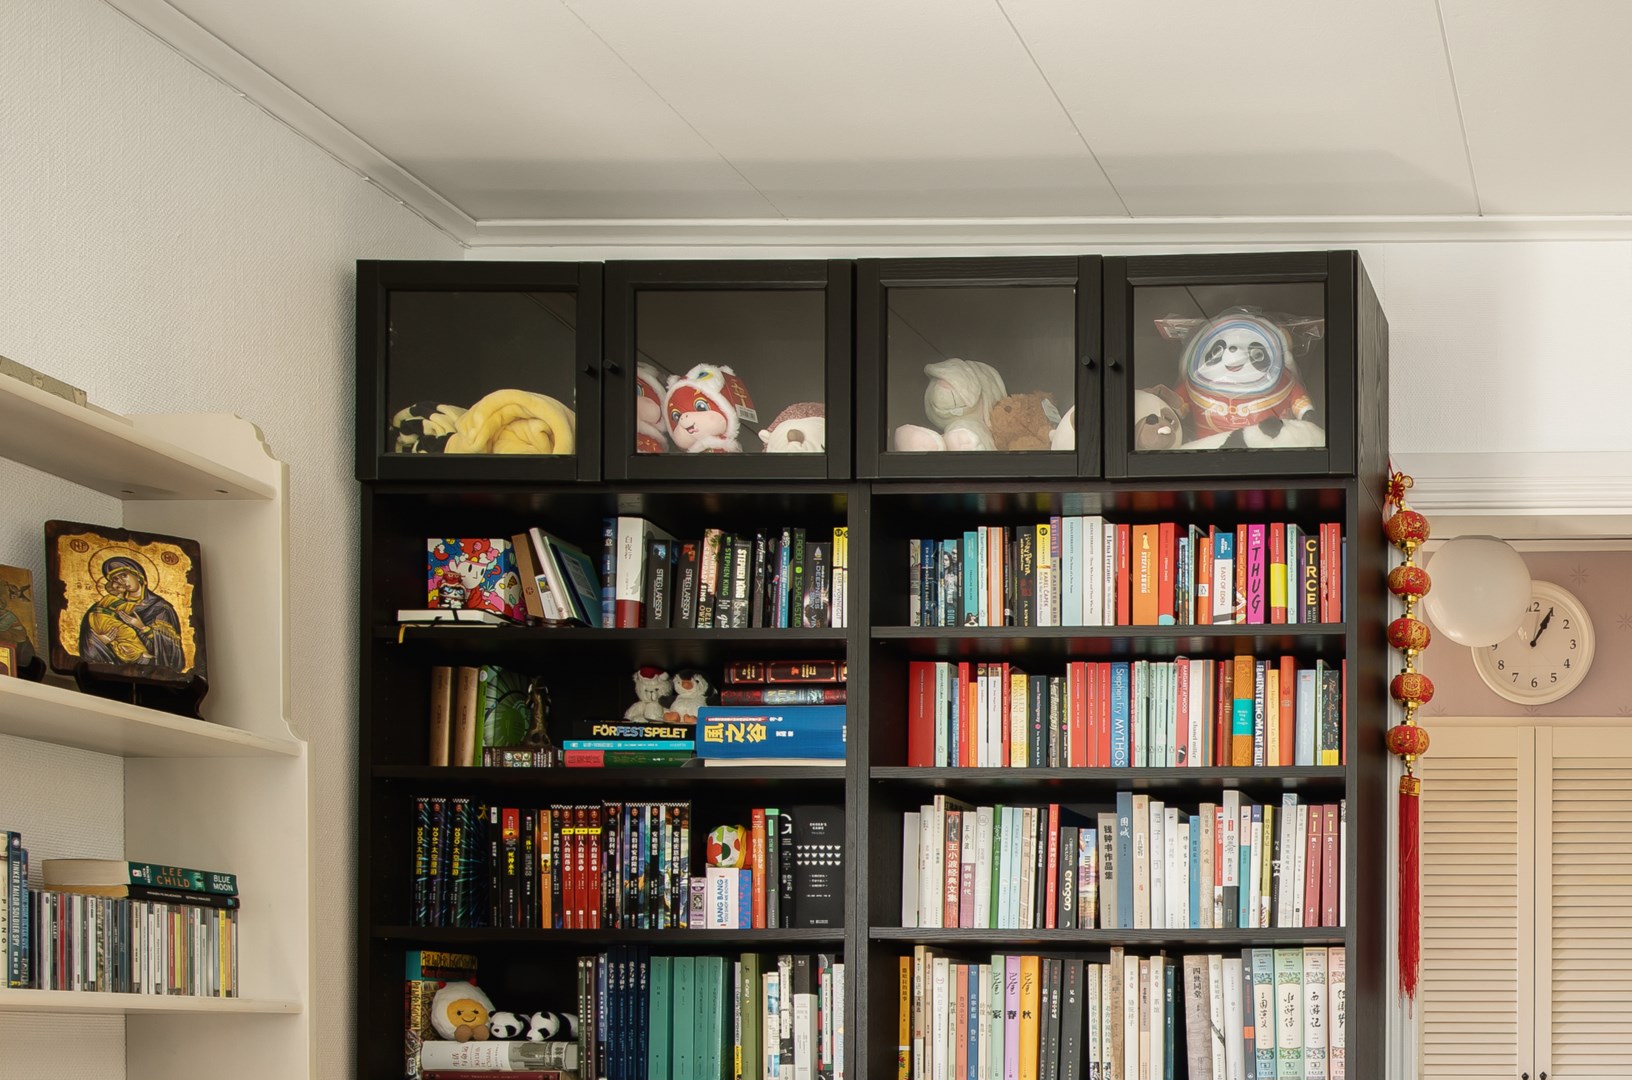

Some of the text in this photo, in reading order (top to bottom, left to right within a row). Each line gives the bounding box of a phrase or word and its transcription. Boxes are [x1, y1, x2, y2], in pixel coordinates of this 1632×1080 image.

[1051, 519, 1059, 553] kosinski
[700, 546, 710, 584] CRAWDADS
[708, 555, 716, 579] WHERE
[735, 549, 748, 598] STEPHEN KING
[1306, 540, 1317, 605] CIRCE
[795, 576, 803, 601] ISAAC
[1251, 547, 1261, 614] THUG
[654, 586, 663, 620] LARSSON
[682, 586, 691, 620] LARSSON
[1563, 619, 1569, 629] 2
[1570, 640, 1576, 649] 3
[1498, 660, 1504, 670] 8
[1563, 658, 1570, 668] 4
[1512, 672, 1519, 682] 7
[1531, 677, 1537, 687] 6
[1550, 673, 1557, 682] 5
[1255, 665, 1264, 713] FRANKENSTEIN
[1114, 668, 1124, 766] Stephen Fry MYTHOS
[592, 724, 687, 739] FÖRFESTSPELET
[1104, 825, 1113, 880] 钱钟书作品集
[156, 875, 190, 886] CHILD
[161, 867, 182, 875] LEE
[214, 875, 230, 884] BLUE
[12, 885, 20, 906] TAILOR
[213, 882, 233, 891] MOON
[1192, 968, 1202, 999] 四世同堂
[1007, 1010, 1017, 1020] 春
[1022, 1010, 1032, 1019] 秋
[1310, 991, 1321, 1028] 西游记
